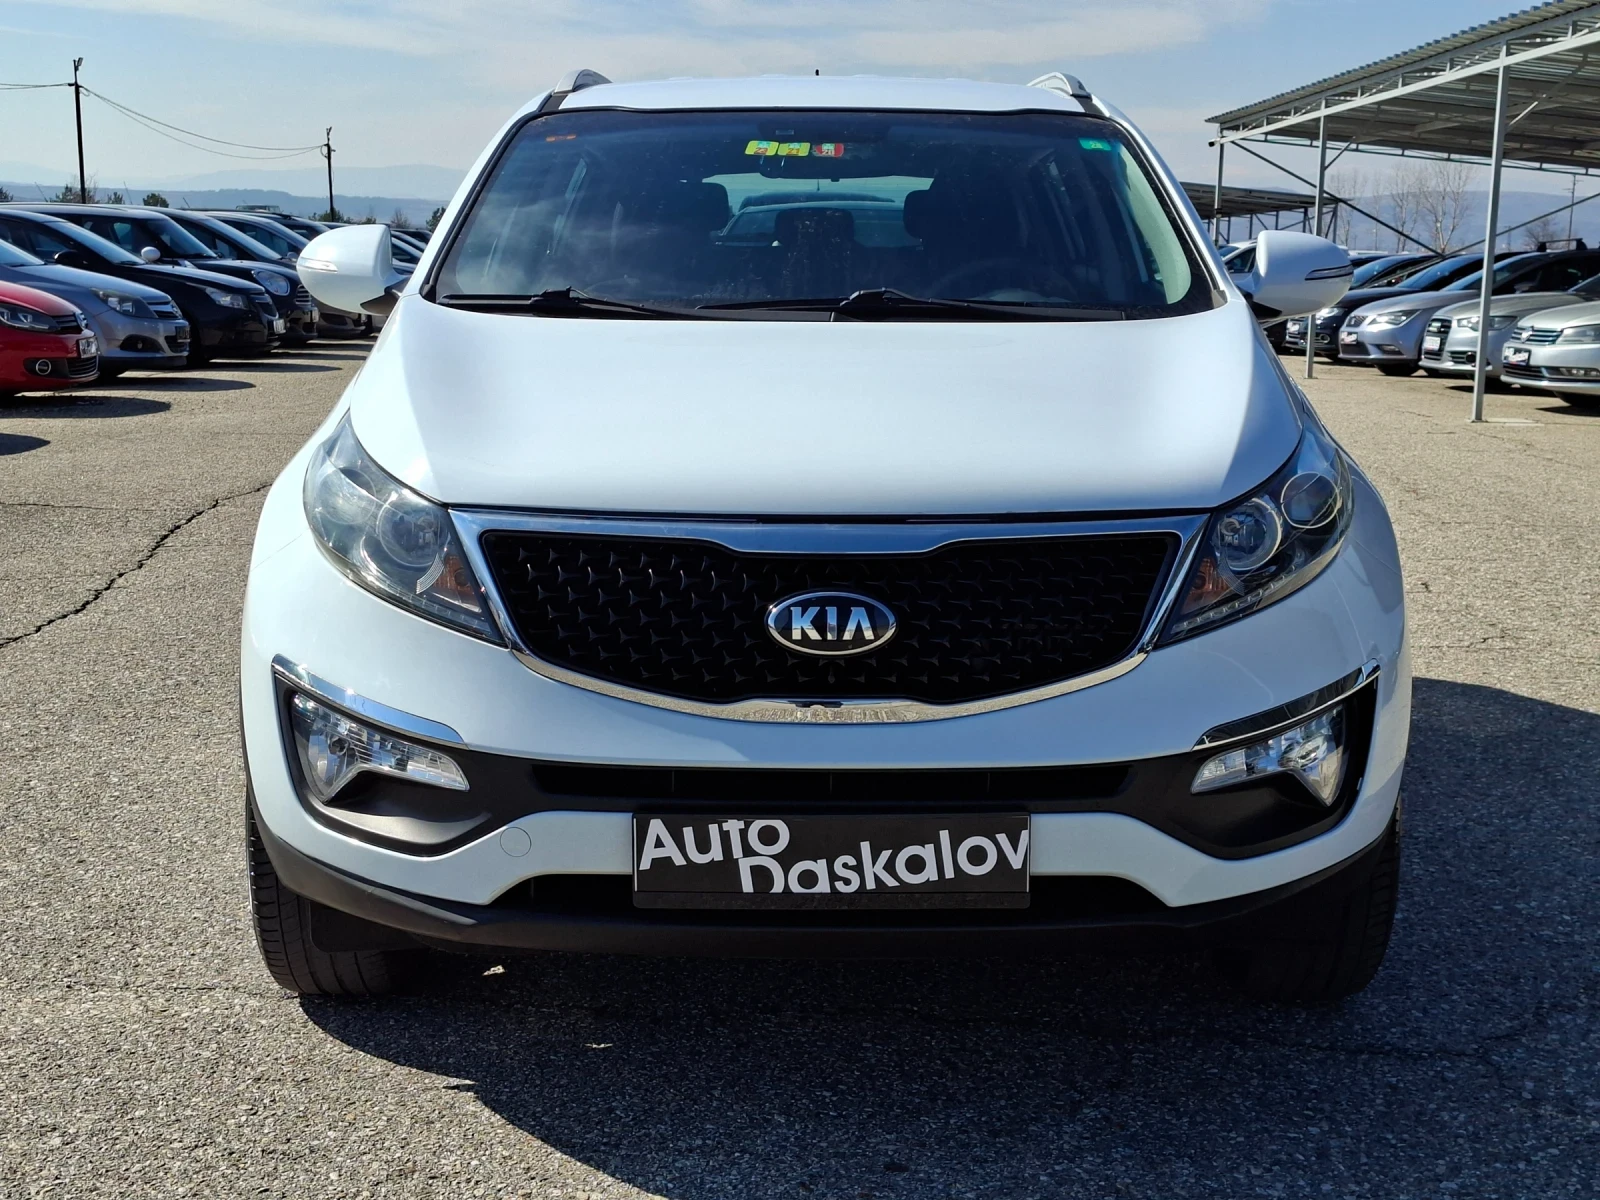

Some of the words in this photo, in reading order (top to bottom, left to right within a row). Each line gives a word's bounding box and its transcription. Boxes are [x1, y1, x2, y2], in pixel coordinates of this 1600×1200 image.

[790, 606, 875, 640] KIA
[639, 819, 790, 870] Auto
[738, 829, 1029, 893] Daskalov
